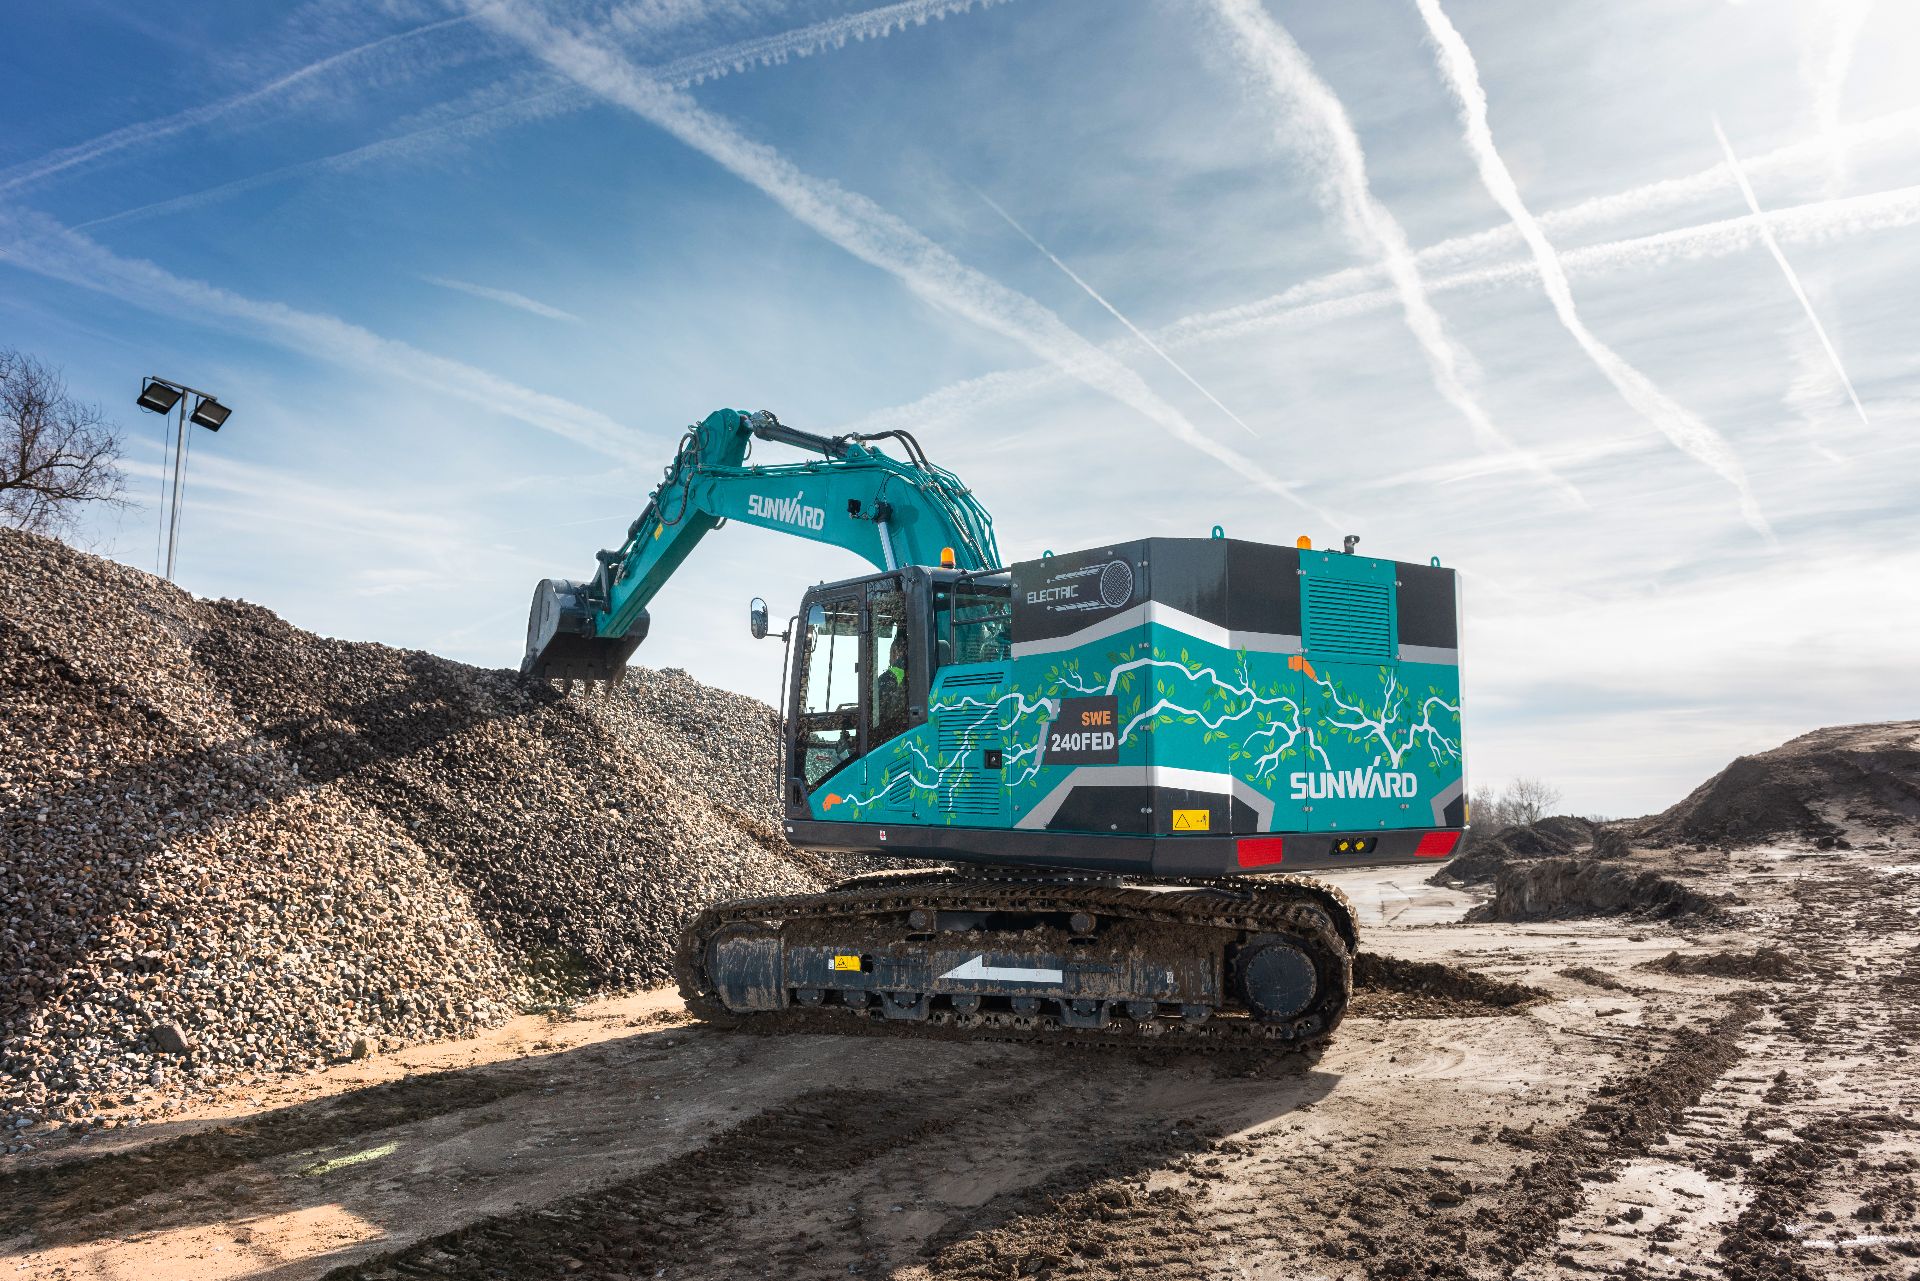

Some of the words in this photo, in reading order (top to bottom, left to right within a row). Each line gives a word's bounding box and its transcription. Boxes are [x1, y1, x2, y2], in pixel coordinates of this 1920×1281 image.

[748, 491, 825, 530] SUNWARD
[1027, 584, 1079, 604] ELECTRIC
[1081, 710, 1112, 727] SWE
[1051, 731, 1115, 751] 240FED
[1290, 756, 1418, 799] SUNWARD
